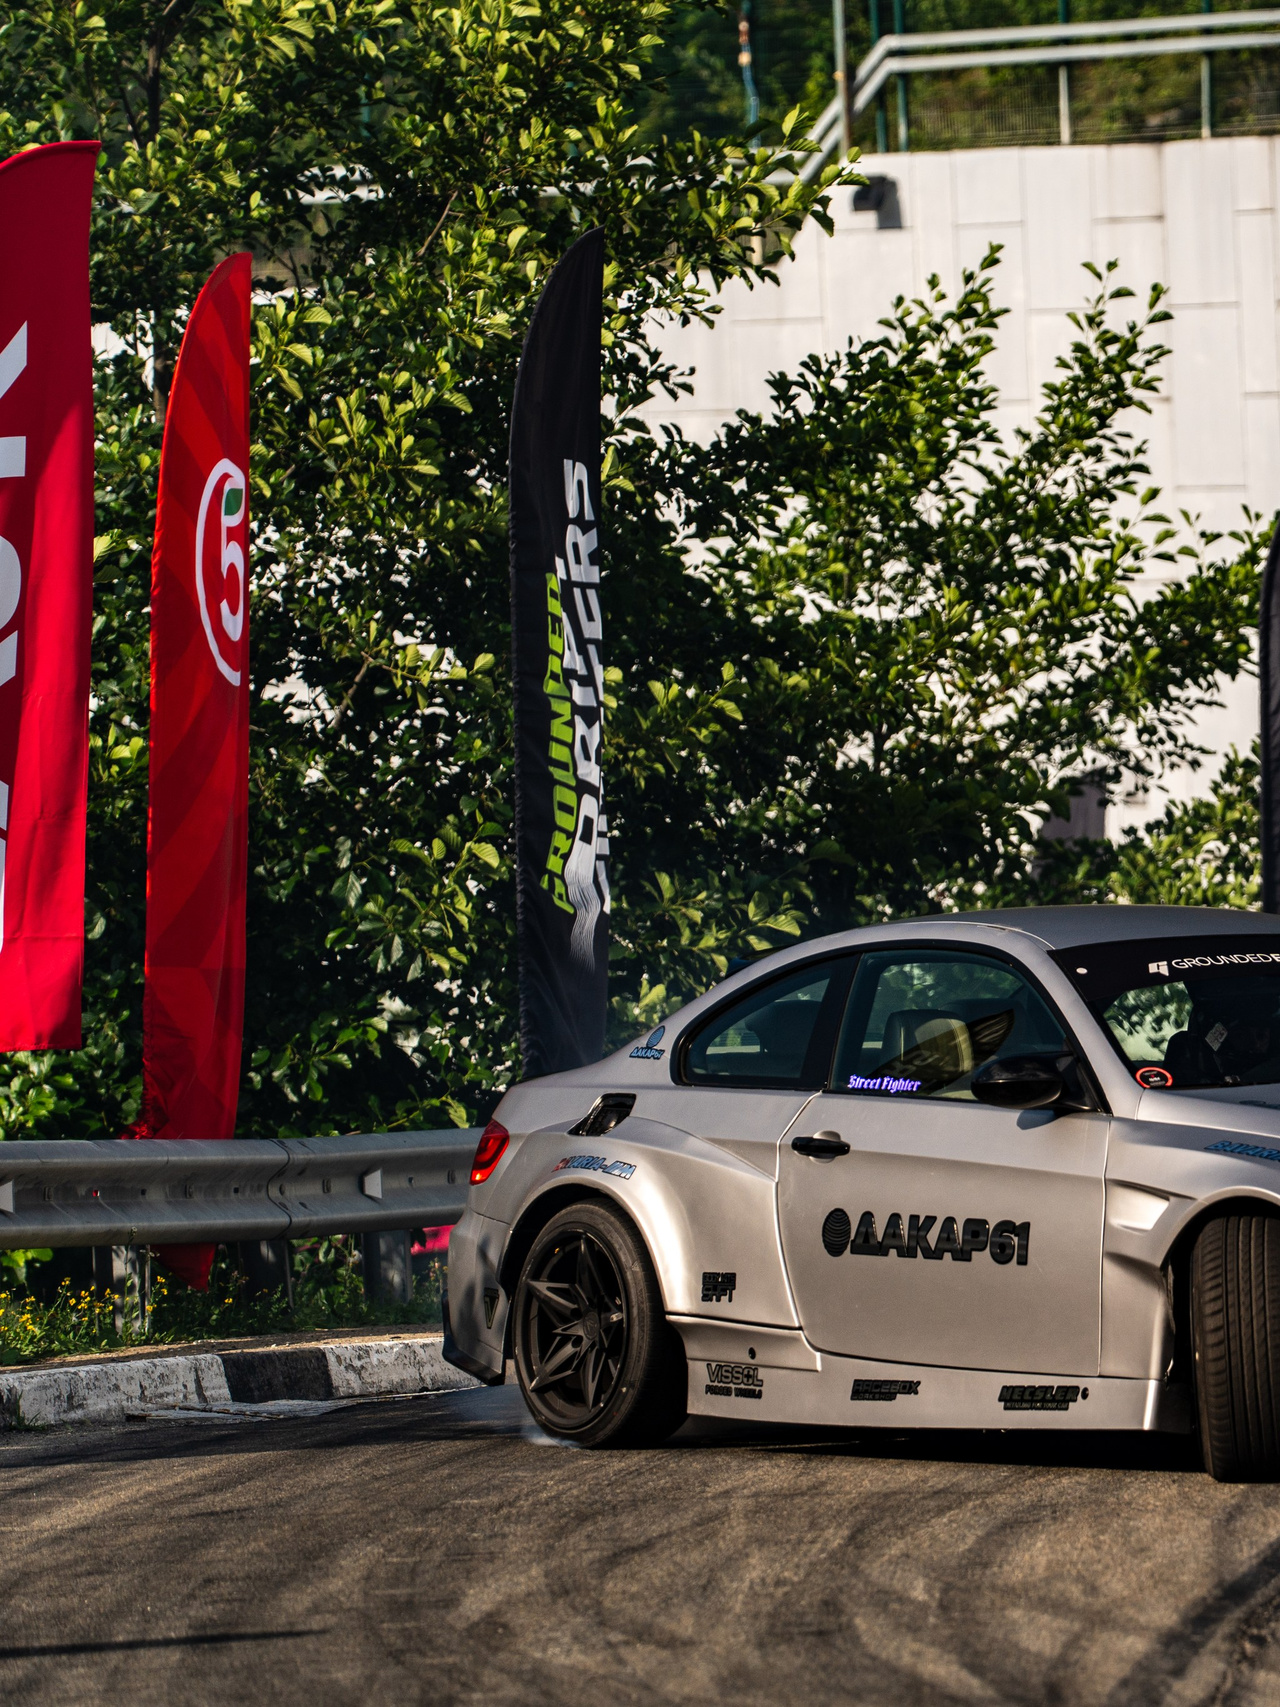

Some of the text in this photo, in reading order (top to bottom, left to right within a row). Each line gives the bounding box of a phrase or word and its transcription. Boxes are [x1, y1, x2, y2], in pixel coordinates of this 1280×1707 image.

[847, 1074, 922, 1093] Street Fighter
[706, 1363, 764, 1387] VISSOL
[998, 1385, 1080, 1402] MECSLER
